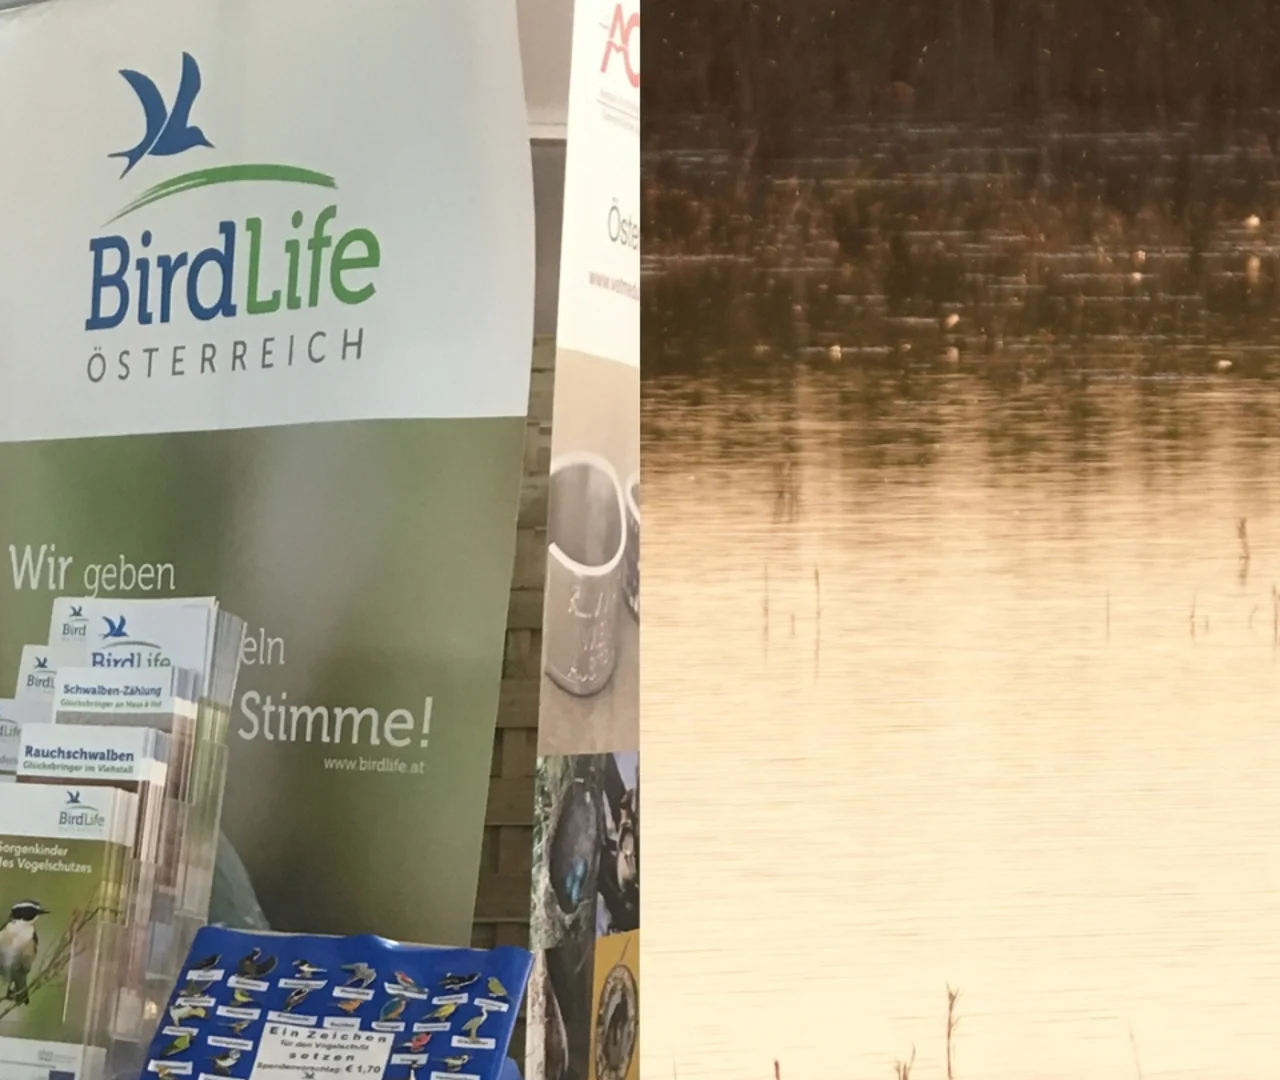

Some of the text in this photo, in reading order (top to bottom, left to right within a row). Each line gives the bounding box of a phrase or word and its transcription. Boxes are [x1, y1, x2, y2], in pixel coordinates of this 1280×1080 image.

[85, 204, 381, 331] BirdLife
[87, 327, 364, 383] ÖSTERREICH
[9, 543, 175, 599] Wir geben
[63, 684, 162, 698] Schwalben-Zählung
[238, 690, 433, 748] Stimme!
[25, 745, 134, 762] Rauchschwalben
[324, 756, 425, 774] www.birdlife.at
[58, 811, 105, 826] BirdLife
[17, 858, 92, 874] Vogelschutzes
